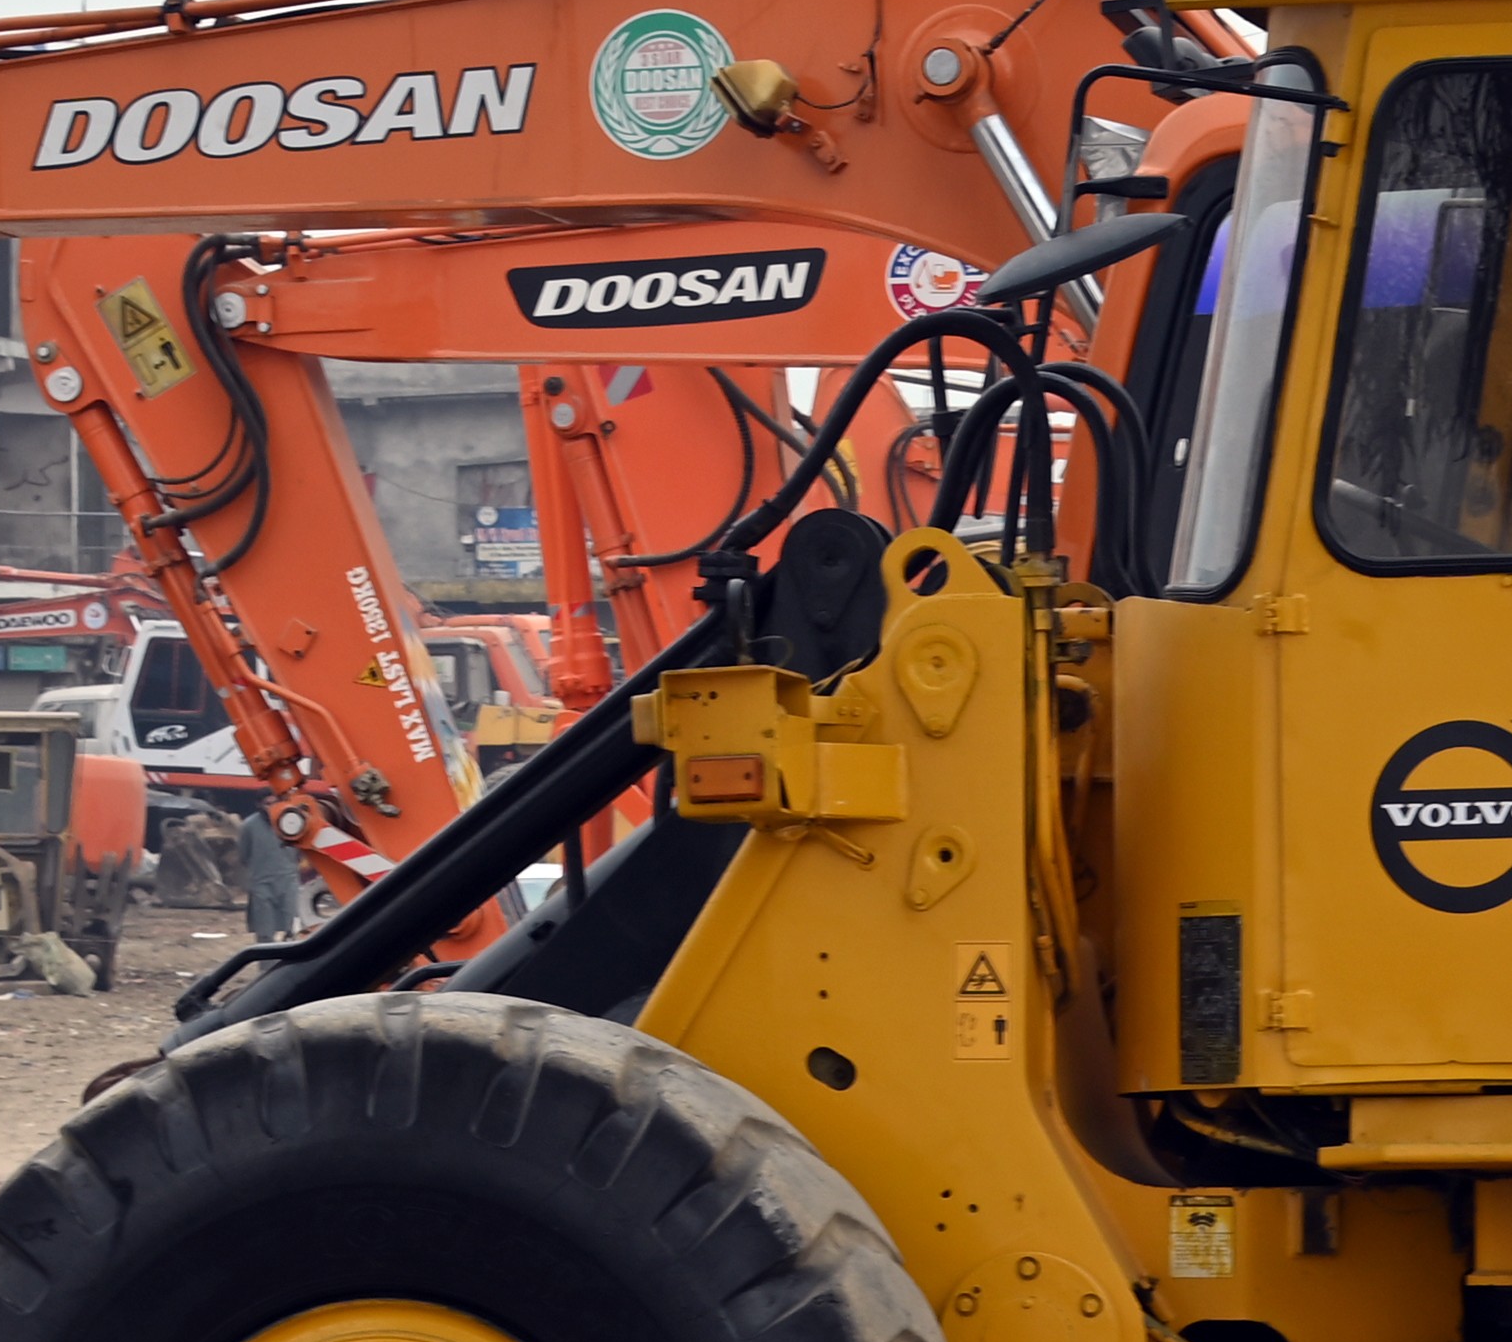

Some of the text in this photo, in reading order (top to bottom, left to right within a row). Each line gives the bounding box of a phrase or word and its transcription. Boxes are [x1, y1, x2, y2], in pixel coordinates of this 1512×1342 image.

[625, 67, 702, 93] DOOSAN
[31, 63, 537, 171] DOOSAN
[533, 261, 811, 318] DOOSAN
